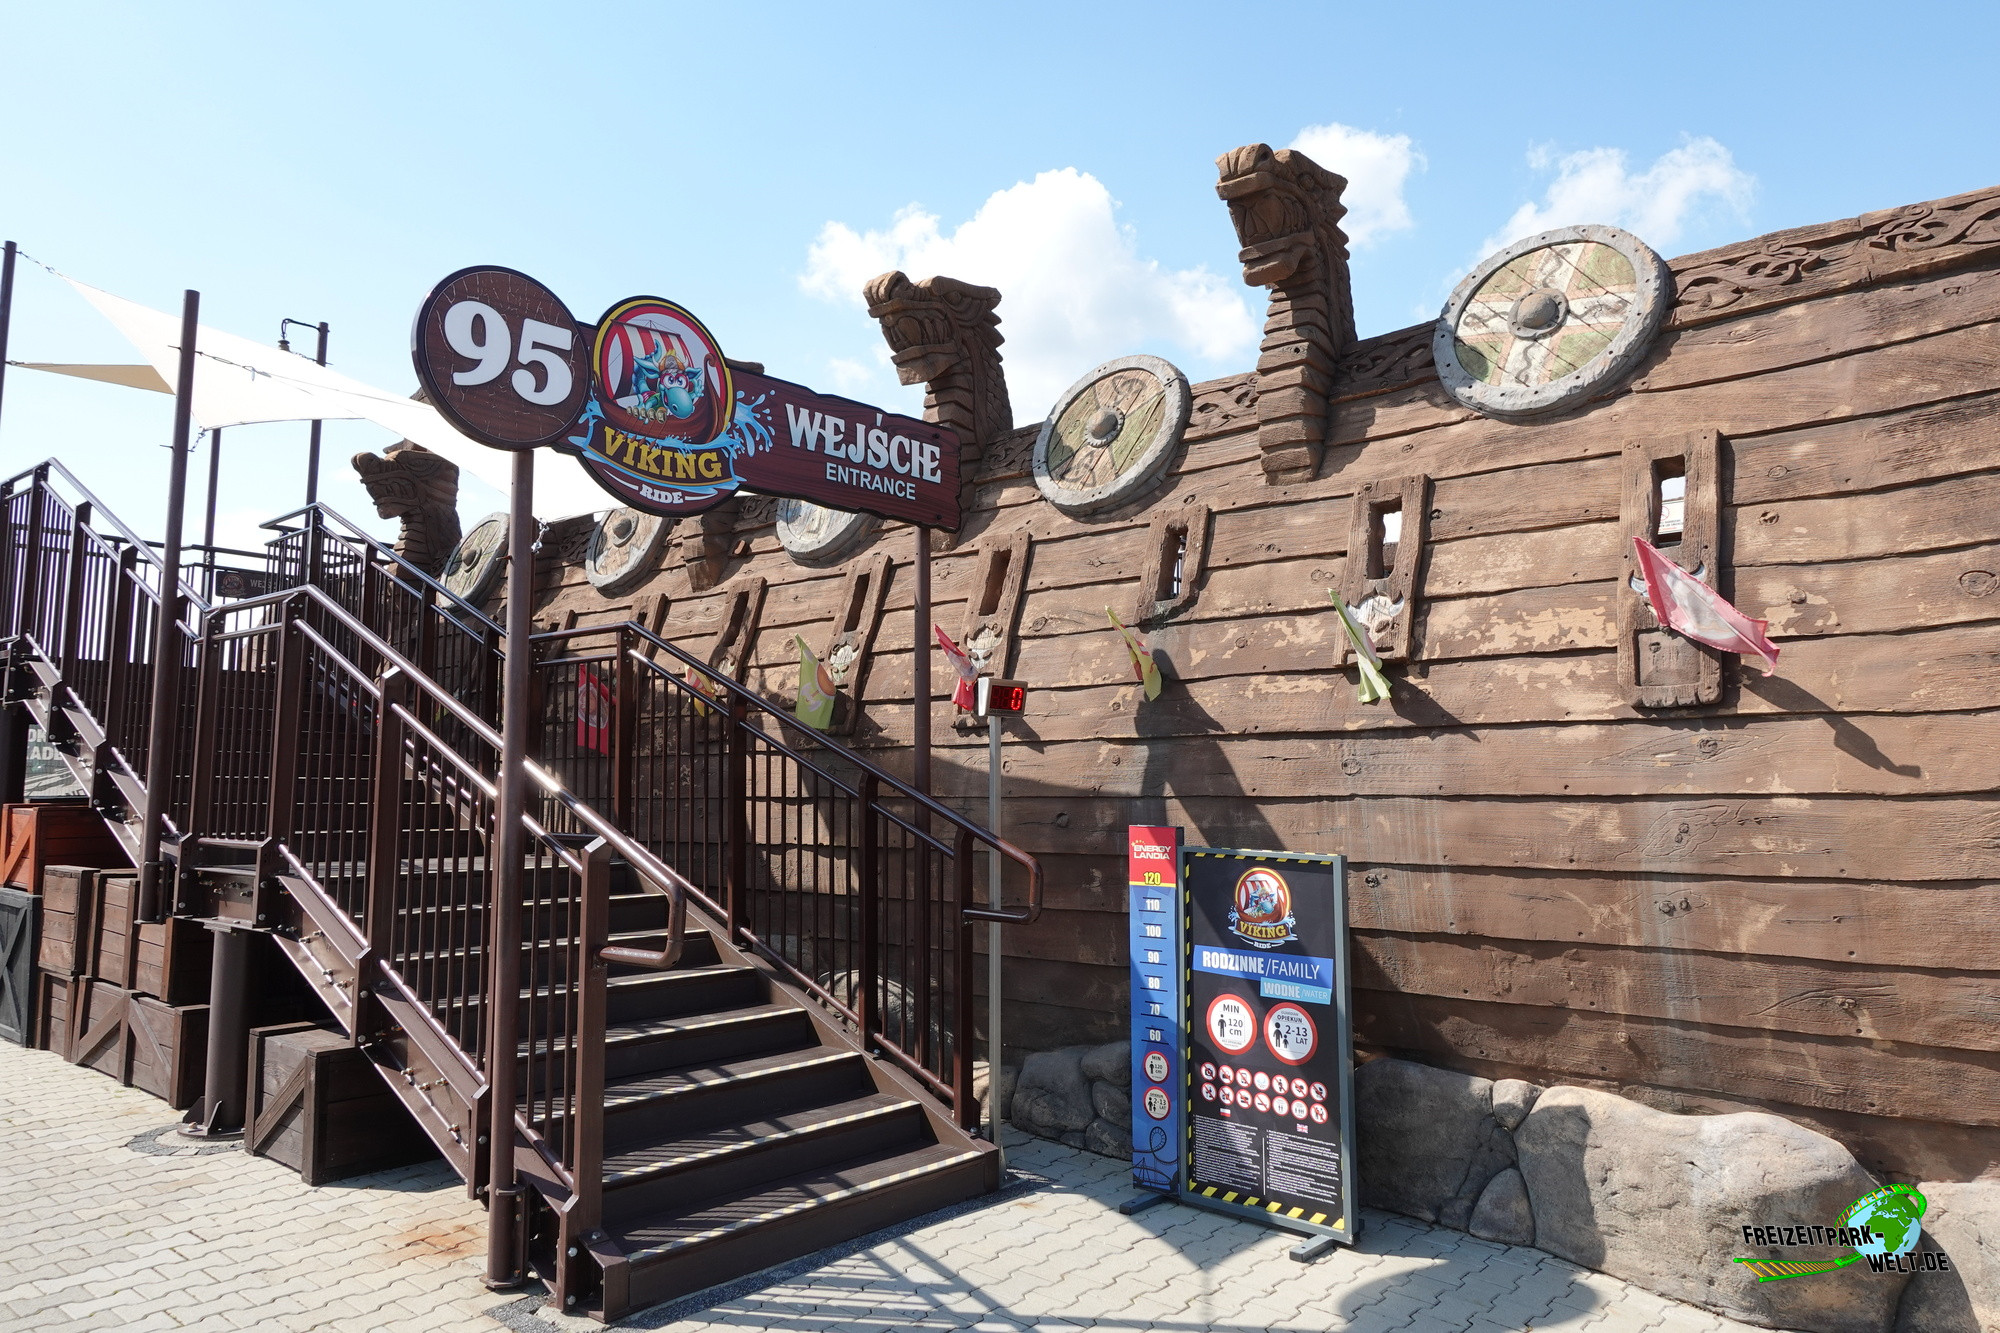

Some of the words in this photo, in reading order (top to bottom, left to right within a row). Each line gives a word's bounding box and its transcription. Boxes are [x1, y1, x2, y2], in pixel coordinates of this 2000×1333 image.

[444, 300, 573, 405] 95
[785, 403, 942, 484] WEJŚCIE
[604, 425, 722, 479] VIKING
[826, 462, 916, 500] ENTRANCE
[640, 484, 684, 504] RIDE
[1133, 844, 1171, 852] ENERGY
[1133, 851, 1170, 860] LANDIA
[1143, 872, 1161, 885] 120
[1146, 899, 1160, 911] 110
[1145, 925, 1161, 937] 100
[1239, 921, 1287, 938] VIKING
[1253, 941, 1272, 949] RIDE
[1147, 951, 1160, 963] 90
[1148, 977, 1160, 989] 80
[1149, 1003, 1160, 1015] 70
[1223, 1004, 1240, 1013] MIN
[1228, 1018, 1243, 1028] 120
[1276, 1014, 1303, 1024] OPIEKUN
[1149, 1029, 1161, 1041] 60
[1285, 1024, 1308, 1037] 2-13
[1295, 1037, 1308, 1045] LAT
